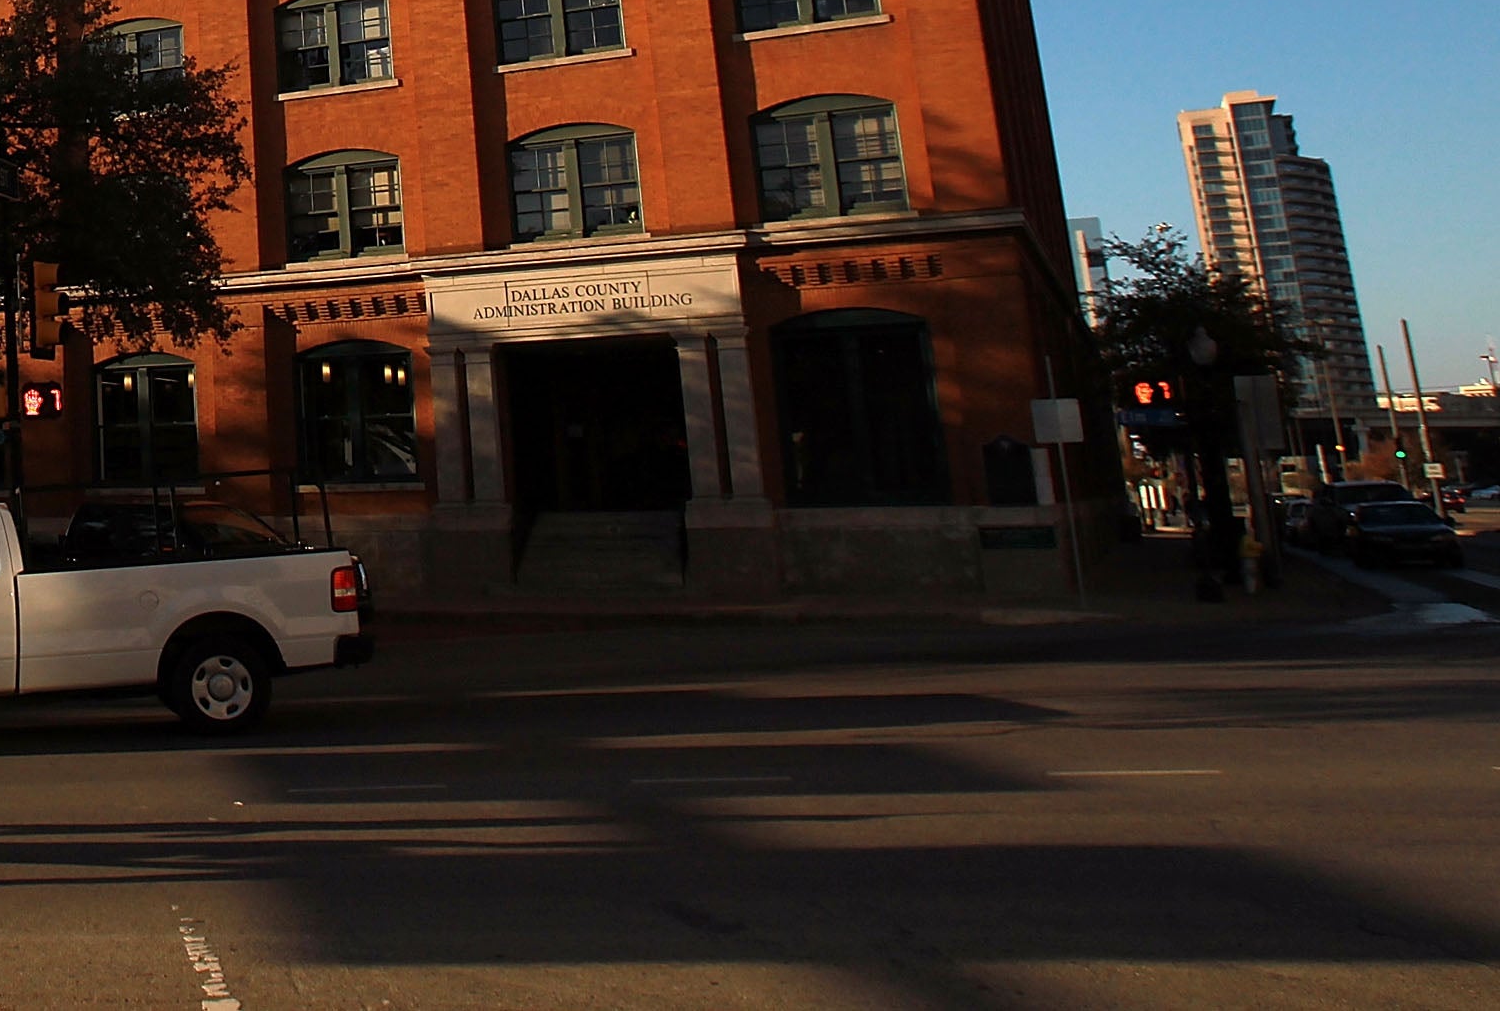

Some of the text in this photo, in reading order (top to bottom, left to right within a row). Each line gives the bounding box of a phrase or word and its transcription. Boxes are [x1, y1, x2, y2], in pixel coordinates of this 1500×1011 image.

[511, 281, 642, 303] DALLAS COUNTY
[473, 293, 693, 320] ADMINISTRATION BUILDING
